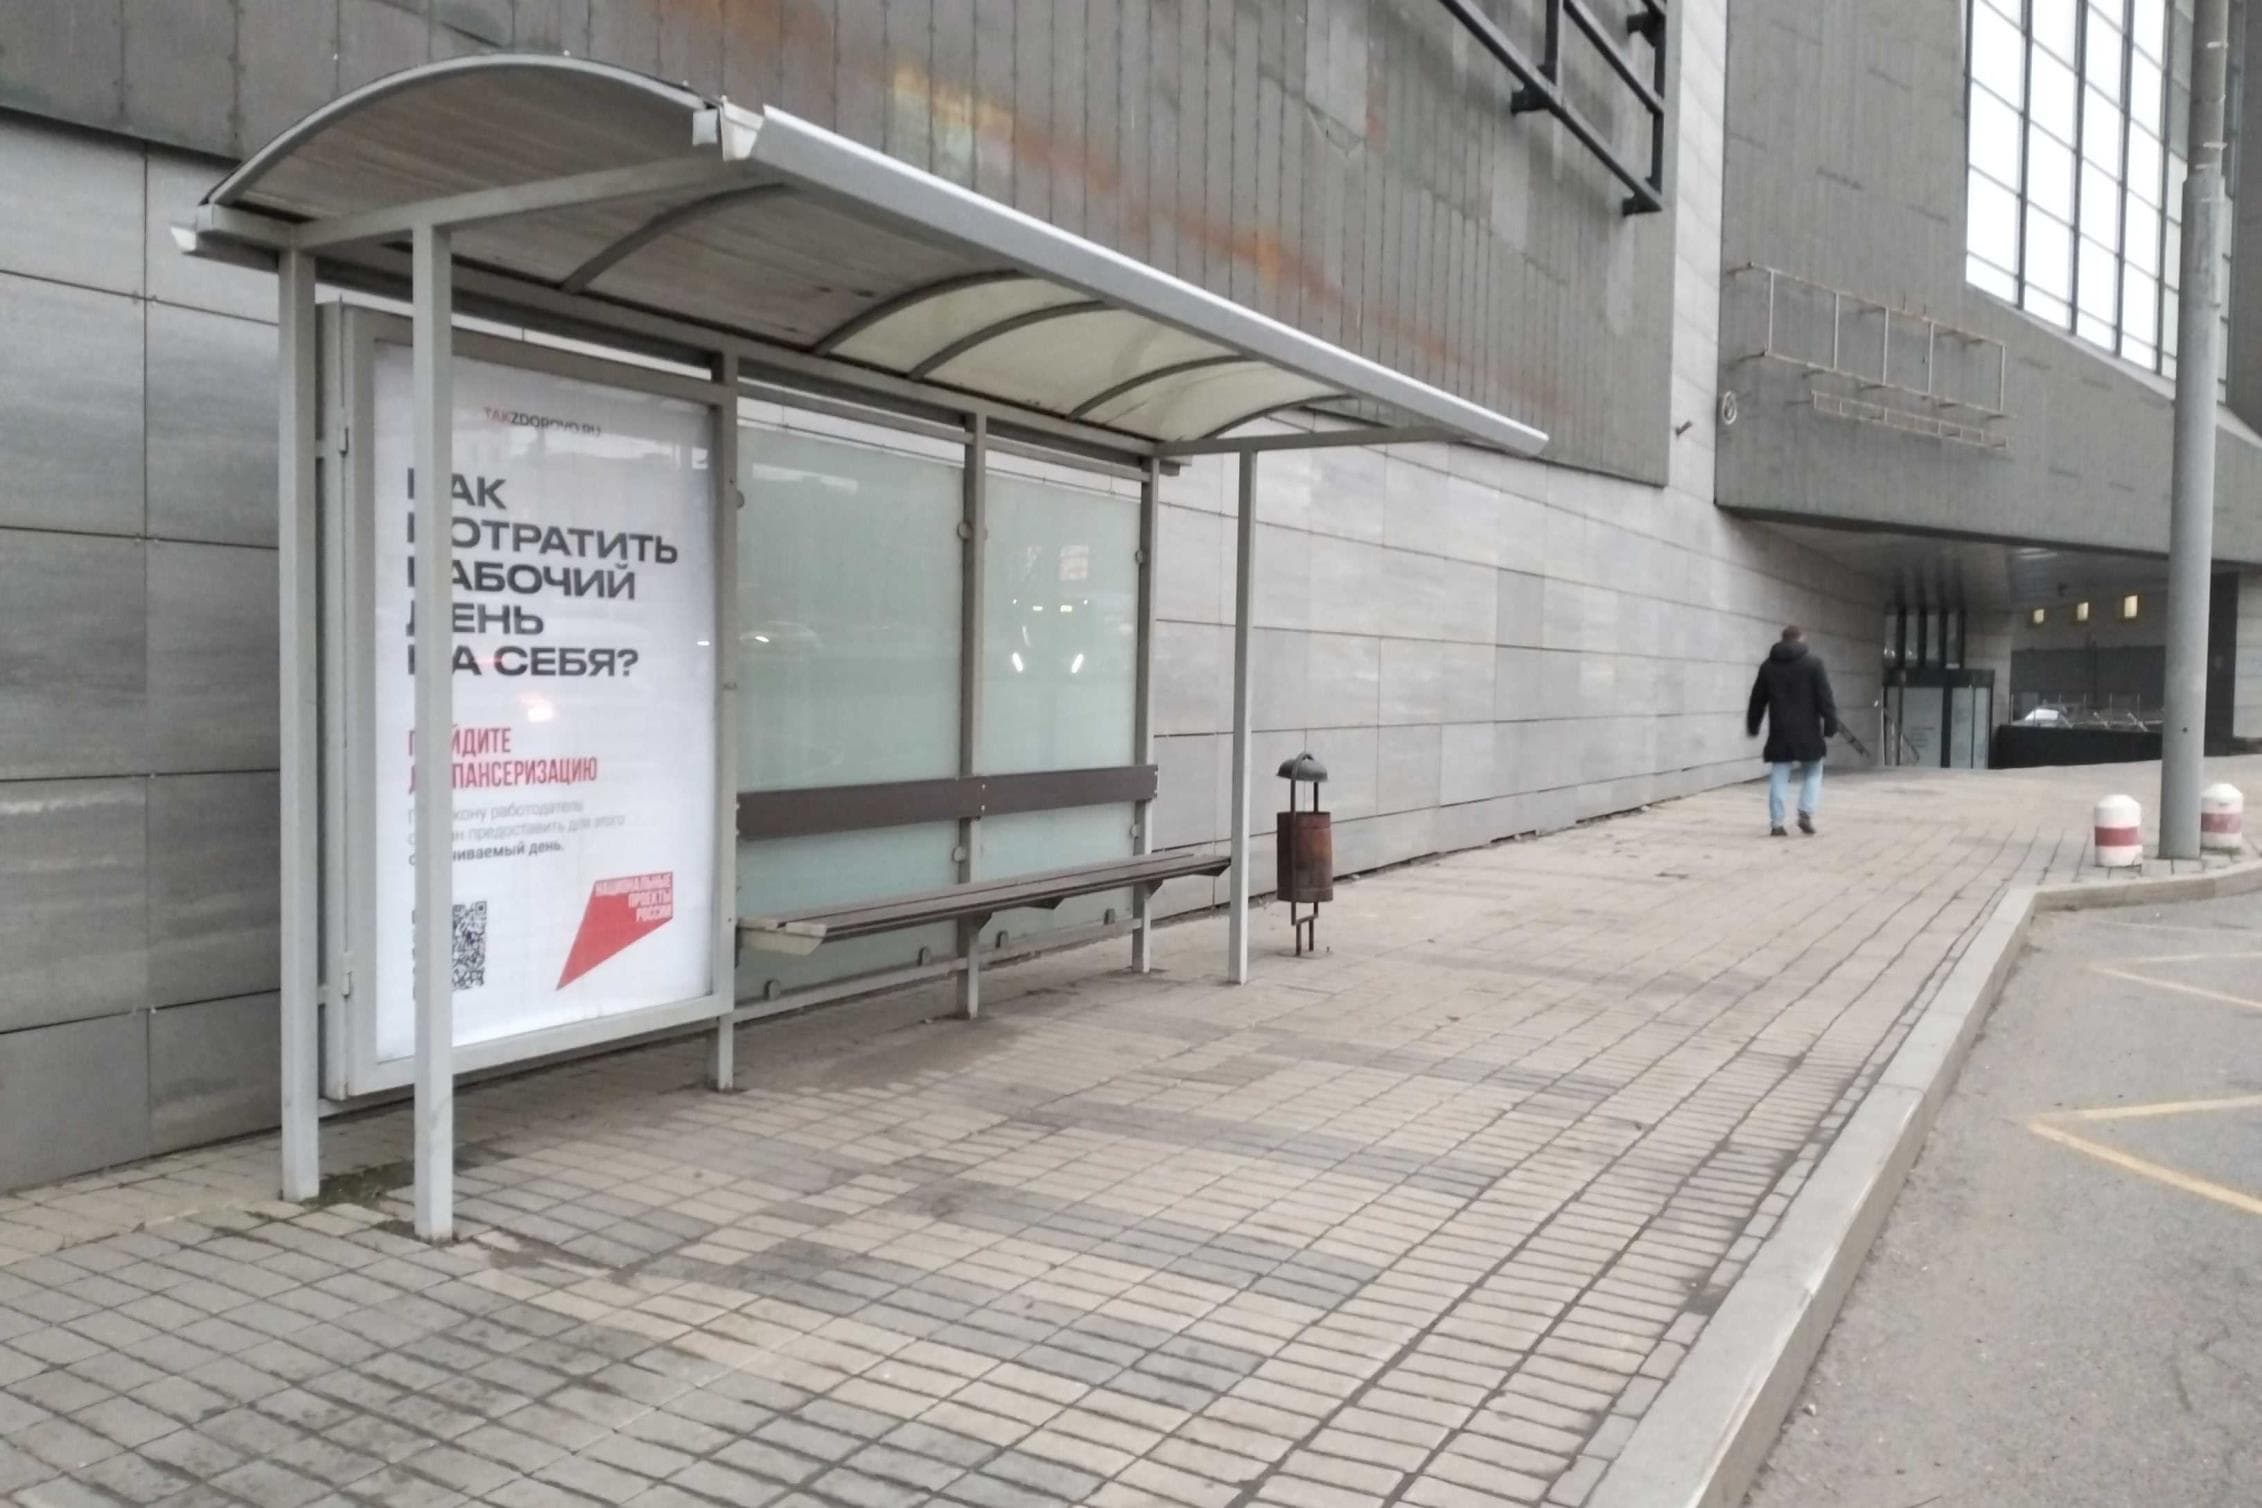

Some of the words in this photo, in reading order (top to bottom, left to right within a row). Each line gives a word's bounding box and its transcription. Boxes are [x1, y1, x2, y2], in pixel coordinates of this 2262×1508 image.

[407, 467, 507, 510] АК
[407, 512, 678, 564] ОТРАТИТЬ
[407, 556, 635, 600] АБОЧИЙ
[406, 600, 544, 636] ЕНЬ
[493, 646, 639, 677] СЕБЯ?
[408, 724, 512, 757] ЙДИТЕ
[408, 756, 598, 795] ПАНСЕРИЗАЦИЮ
